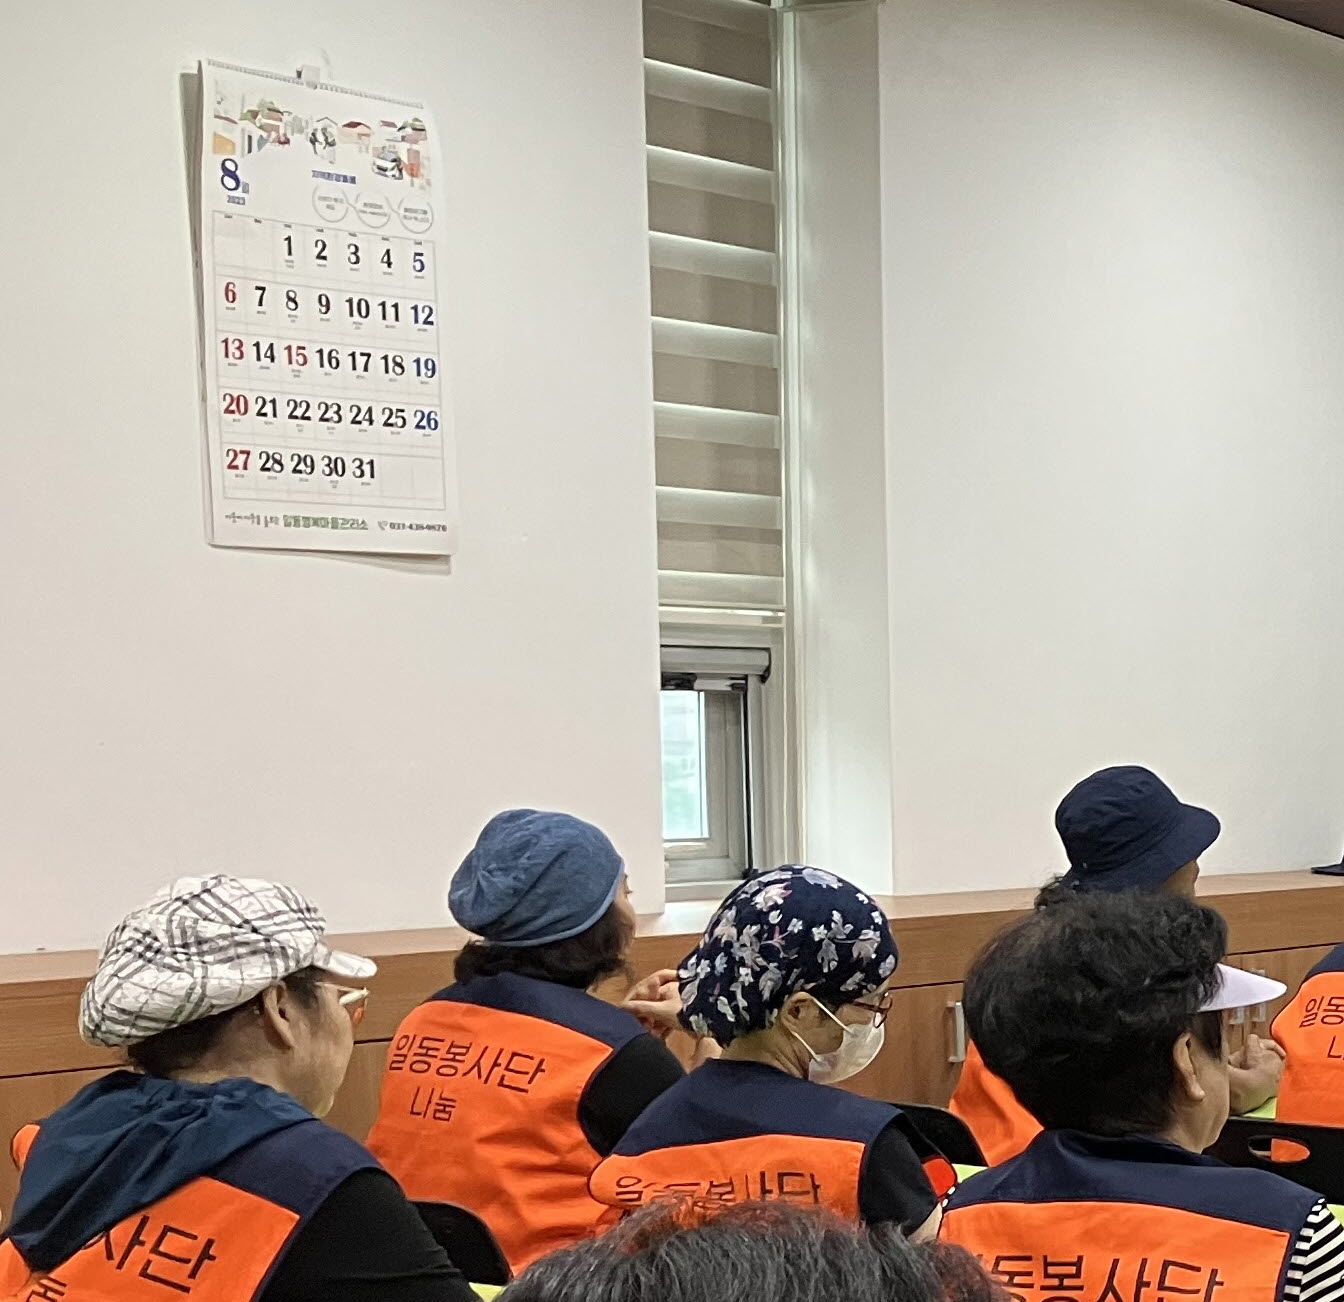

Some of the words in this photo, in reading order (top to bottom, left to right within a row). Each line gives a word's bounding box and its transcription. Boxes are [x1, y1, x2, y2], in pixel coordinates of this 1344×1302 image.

[284, 235, 293, 257] 1
[315, 239, 328, 261] 2
[348, 243, 360, 265] 3
[380, 248, 393, 269] 4
[413, 252, 425, 273] 5
[224, 281, 237, 304] 6
[254, 285, 267, 307] 7
[286, 289, 299, 311] 8
[318, 293, 331, 315] 9
[345, 297, 370, 319] 10
[377, 301, 400, 323] 11
[410, 304, 434, 326] 12
[221, 338, 244, 361] 13
[252, 341, 275, 363] 14
[284, 344, 308, 367] 15
[315, 348, 340, 370] 16
[348, 351, 372, 373] 17
[380, 354, 405, 376] 18
[413, 357, 436, 379] 19
[223, 393, 248, 416] 20
[255, 396, 278, 418] 21
[287, 399, 312, 421] 22
[318, 401, 343, 424] 23
[350, 404, 374, 426] 24
[382, 407, 407, 429] 25
[414, 409, 439, 431] 26
[226, 448, 251, 471] 27
[259, 451, 284, 473] 28
[291, 453, 315, 475] 29
[321, 455, 346, 477] 30
[352, 458, 375, 479] 31
[389, 1034, 546, 1093] 일동봉사단
[410, 1086, 457, 1122] 나눔
